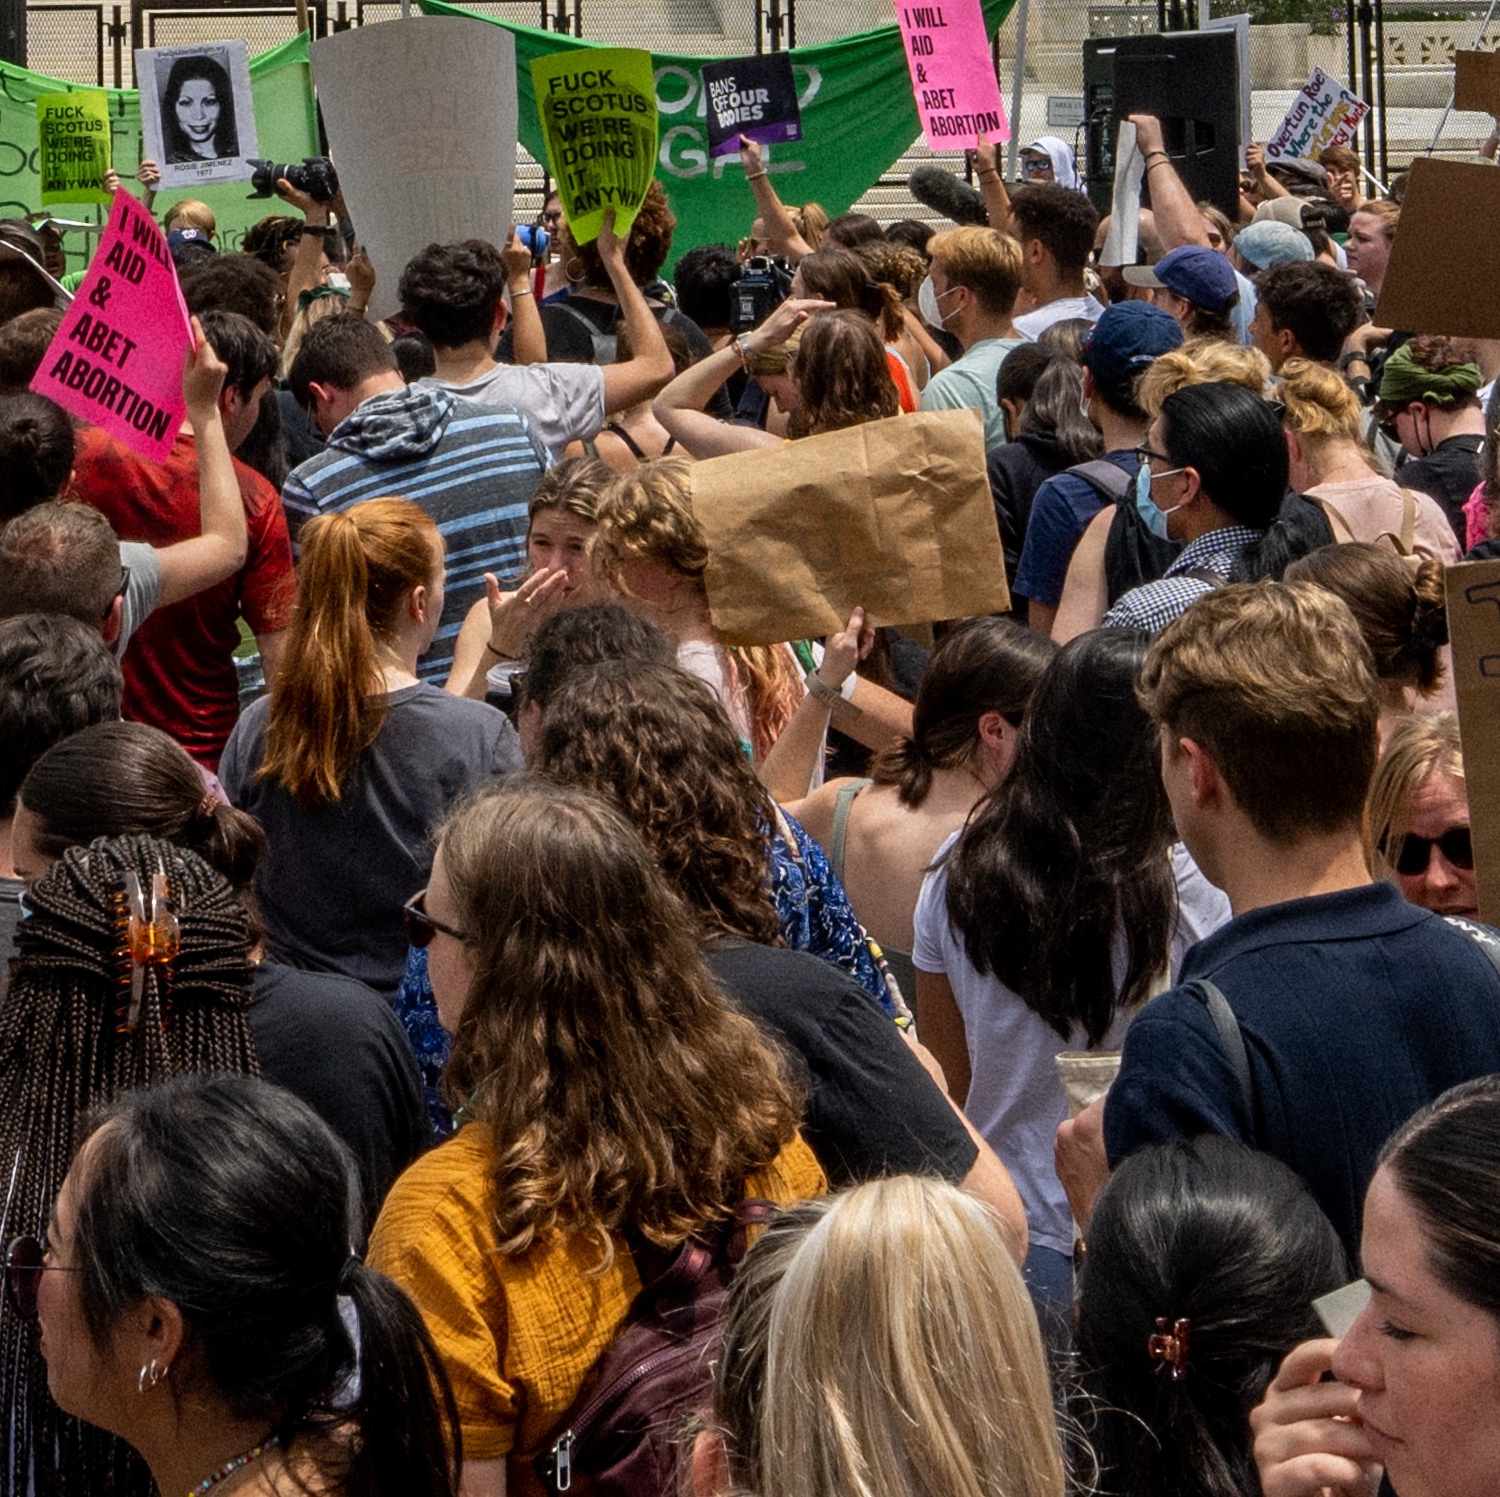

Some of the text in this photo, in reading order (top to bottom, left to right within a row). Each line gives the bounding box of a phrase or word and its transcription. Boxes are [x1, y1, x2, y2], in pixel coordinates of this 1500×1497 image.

[904, 6, 948, 29] I WILL
[911, 35, 934, 56] AID
[548, 69, 616, 95] FUCK
[916, 63, 928, 83] &
[709, 76, 736, 98] BANS
[552, 93, 648, 119] SCOTUS
[712, 88, 770, 113] OFF OUR
[922, 88, 956, 110] ABET
[45, 106, 84, 119] FUCK
[717, 105, 764, 129] BODIES
[930, 111, 1000, 137] ABORTION
[45, 119, 103, 134] SCOTUS
[556, 117, 633, 142] WE'RE
[46, 136, 92, 148] WE'RE
[562, 140, 635, 166] DOING
[47, 150, 93, 163] DOING
[174, 158, 232, 172] ROSIE JIMENEZ
[196, 168, 212, 177] 1977
[567, 168, 587, 191] IT
[117, 205, 129, 232] I
[132, 214, 173, 274] WILL
[104, 241, 147, 285] AID
[88, 275, 112, 311] &
[68, 312, 137, 369] ABET
[50, 350, 172, 442] ABORTION
